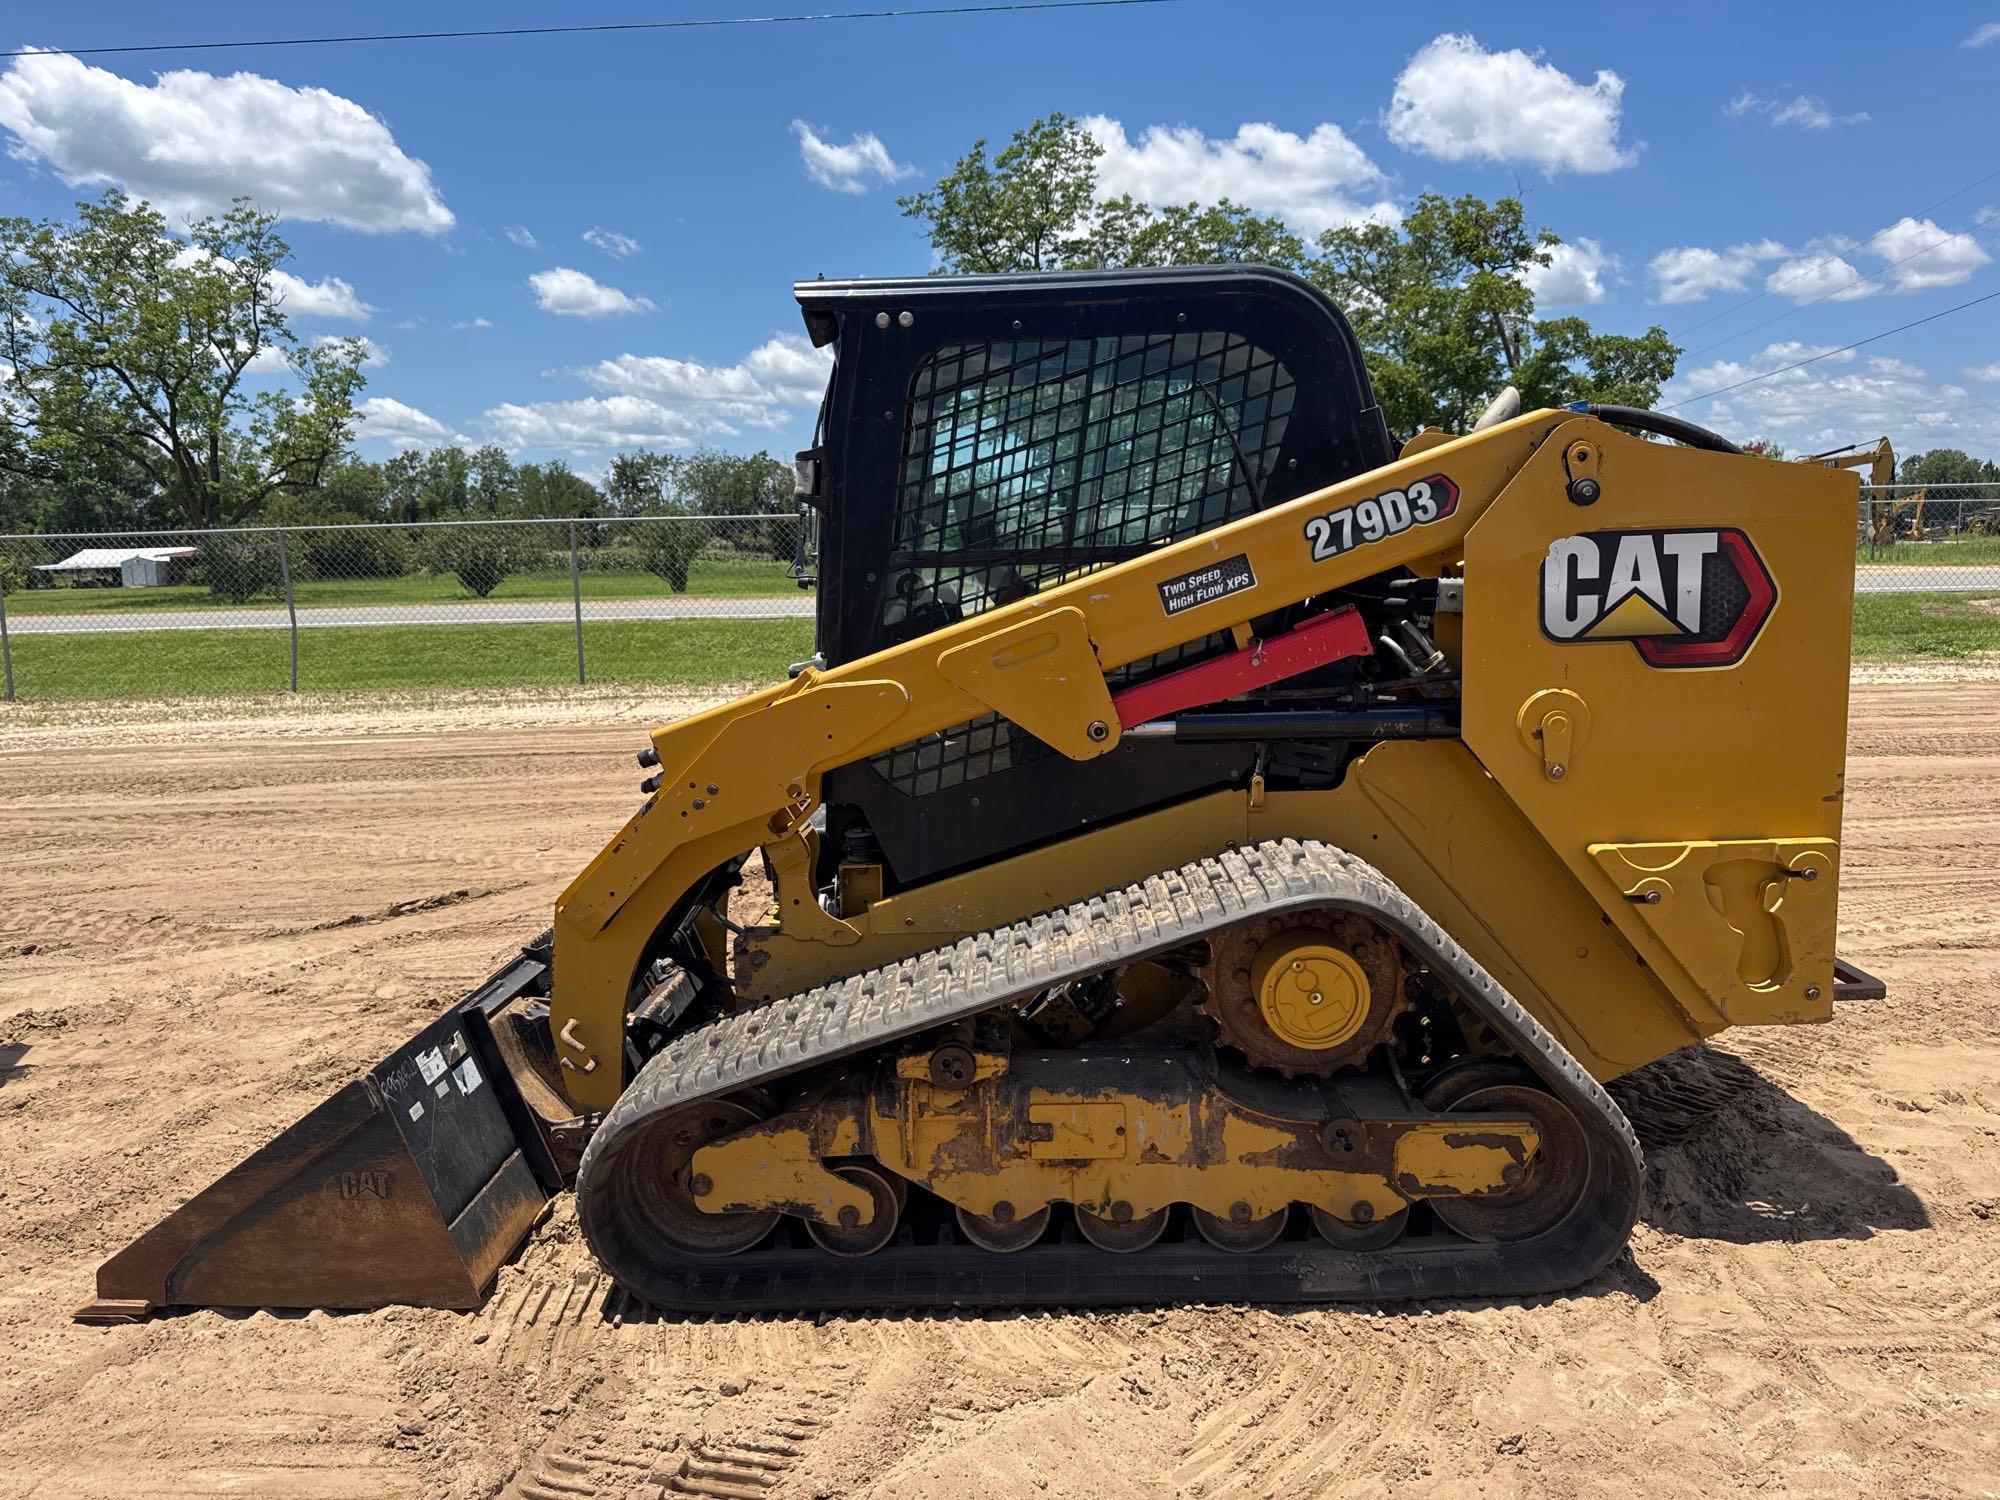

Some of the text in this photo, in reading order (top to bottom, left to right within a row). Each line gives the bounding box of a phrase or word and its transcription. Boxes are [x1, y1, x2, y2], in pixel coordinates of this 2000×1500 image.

[1306, 482, 1438, 561] 279D3
[1163, 569, 1221, 597] TWO SPEED
[1169, 573, 1249, 611] HIGH FLOW XPS
[1544, 532, 1718, 638] CAT
[342, 1171, 391, 1200] CAT
